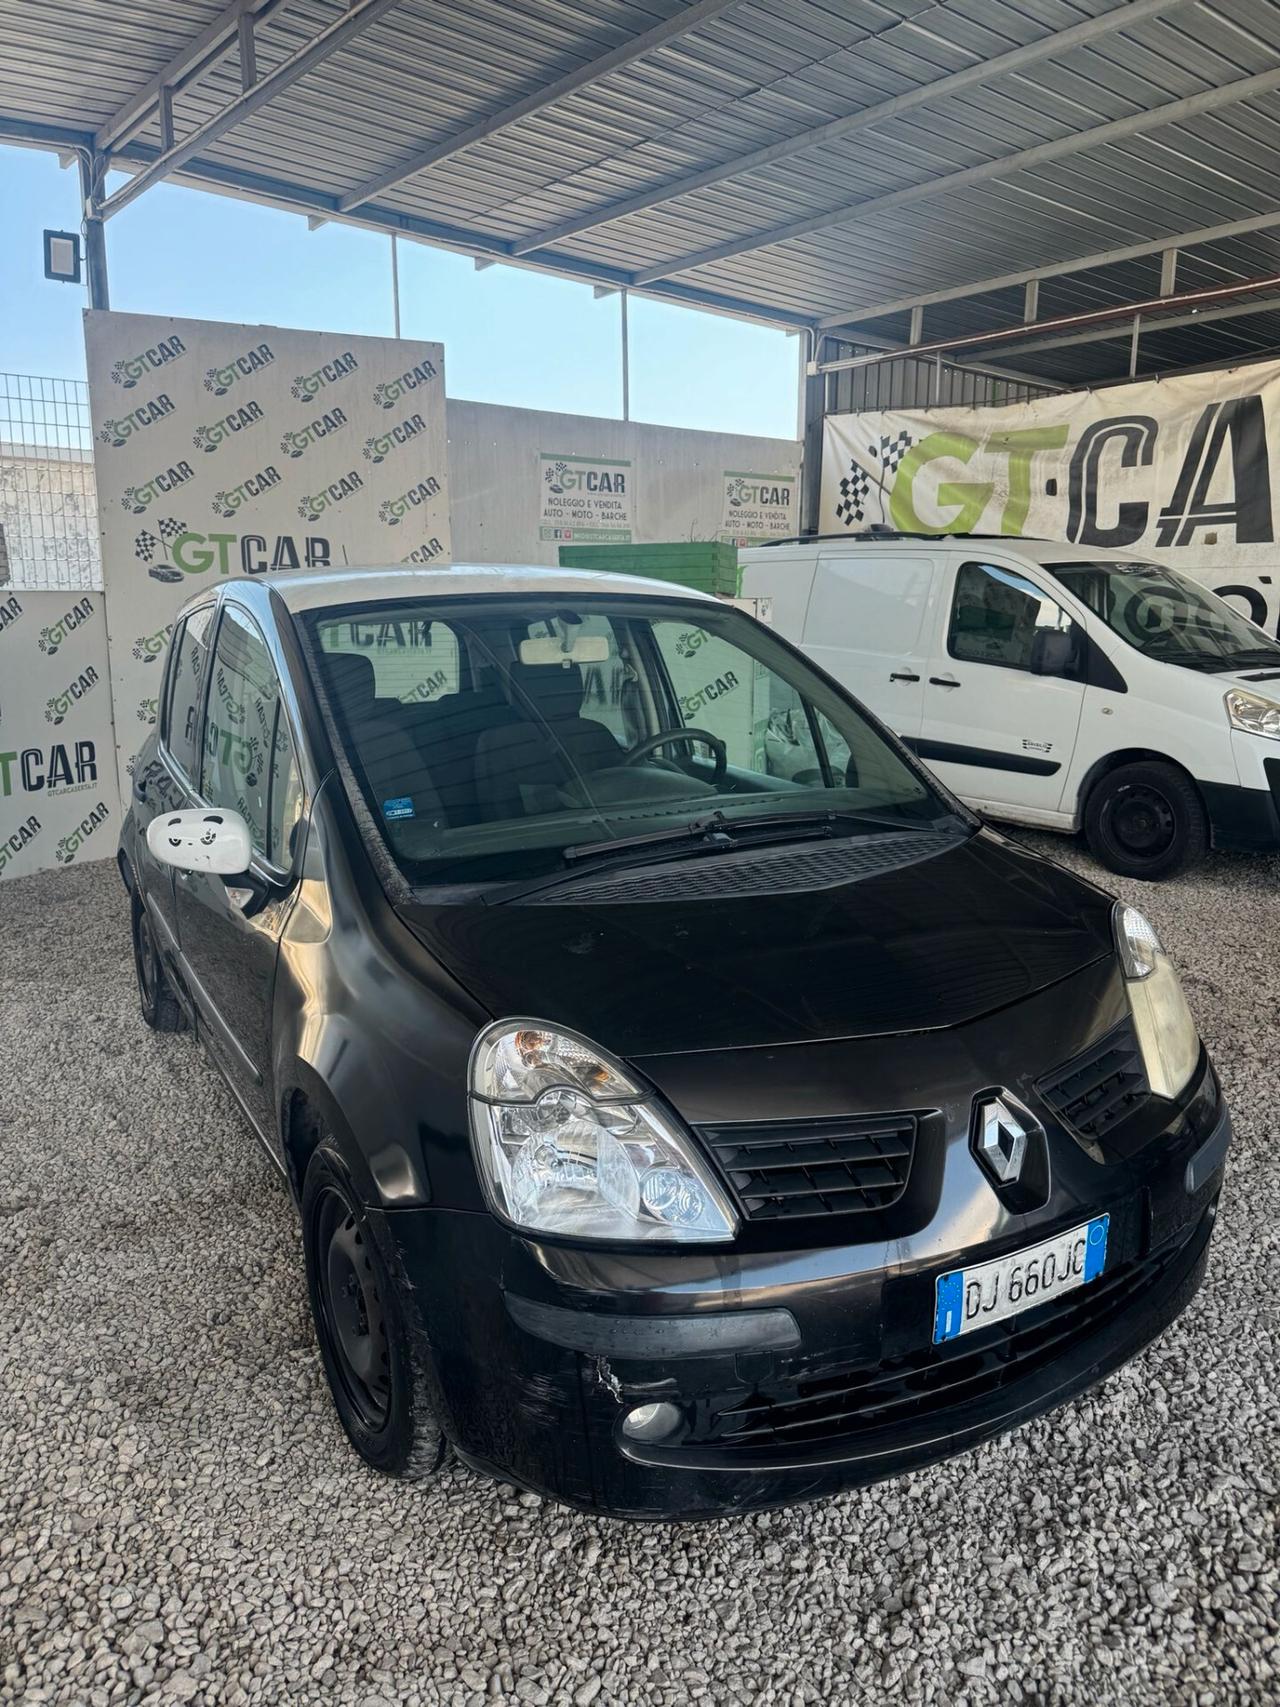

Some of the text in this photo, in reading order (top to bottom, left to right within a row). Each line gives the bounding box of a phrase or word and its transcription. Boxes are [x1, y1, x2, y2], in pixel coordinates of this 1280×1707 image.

[124, 335, 186, 379] GTCAR
[216, 344, 274, 387] GTCAR
[302, 352, 358, 393] GTCAR
[384, 360, 437, 401] GTCAR
[113, 394, 176, 438] GTCAR
[205, 401, 264, 444] GTCAR
[292, 407, 348, 449] GTCAR
[374, 414, 426, 455] GTCAR
[134, 461, 195, 505] GTCAR
[224, 466, 282, 508] GTCAR
[309, 471, 364, 513] GTCAR
[390, 476, 441, 517] GTCAR
[560, 470, 625, 493] GTCAR
[739, 484, 790, 506] GTCAR
[544, 508, 563, 517] AUTO
[572, 511, 593, 519] MOTO
[172, 532, 331, 575] GTCAR
[401, 538, 444, 563] CAR
[48, 597, 94, 645] GTCAR
[55, 666, 99, 715] GTCAR
[399, 670, 448, 703] TCAR
[686, 671, 739, 712] GTCAR
[0, 740, 97, 797] TCAR
[65, 802, 109, 853] GTCAR
